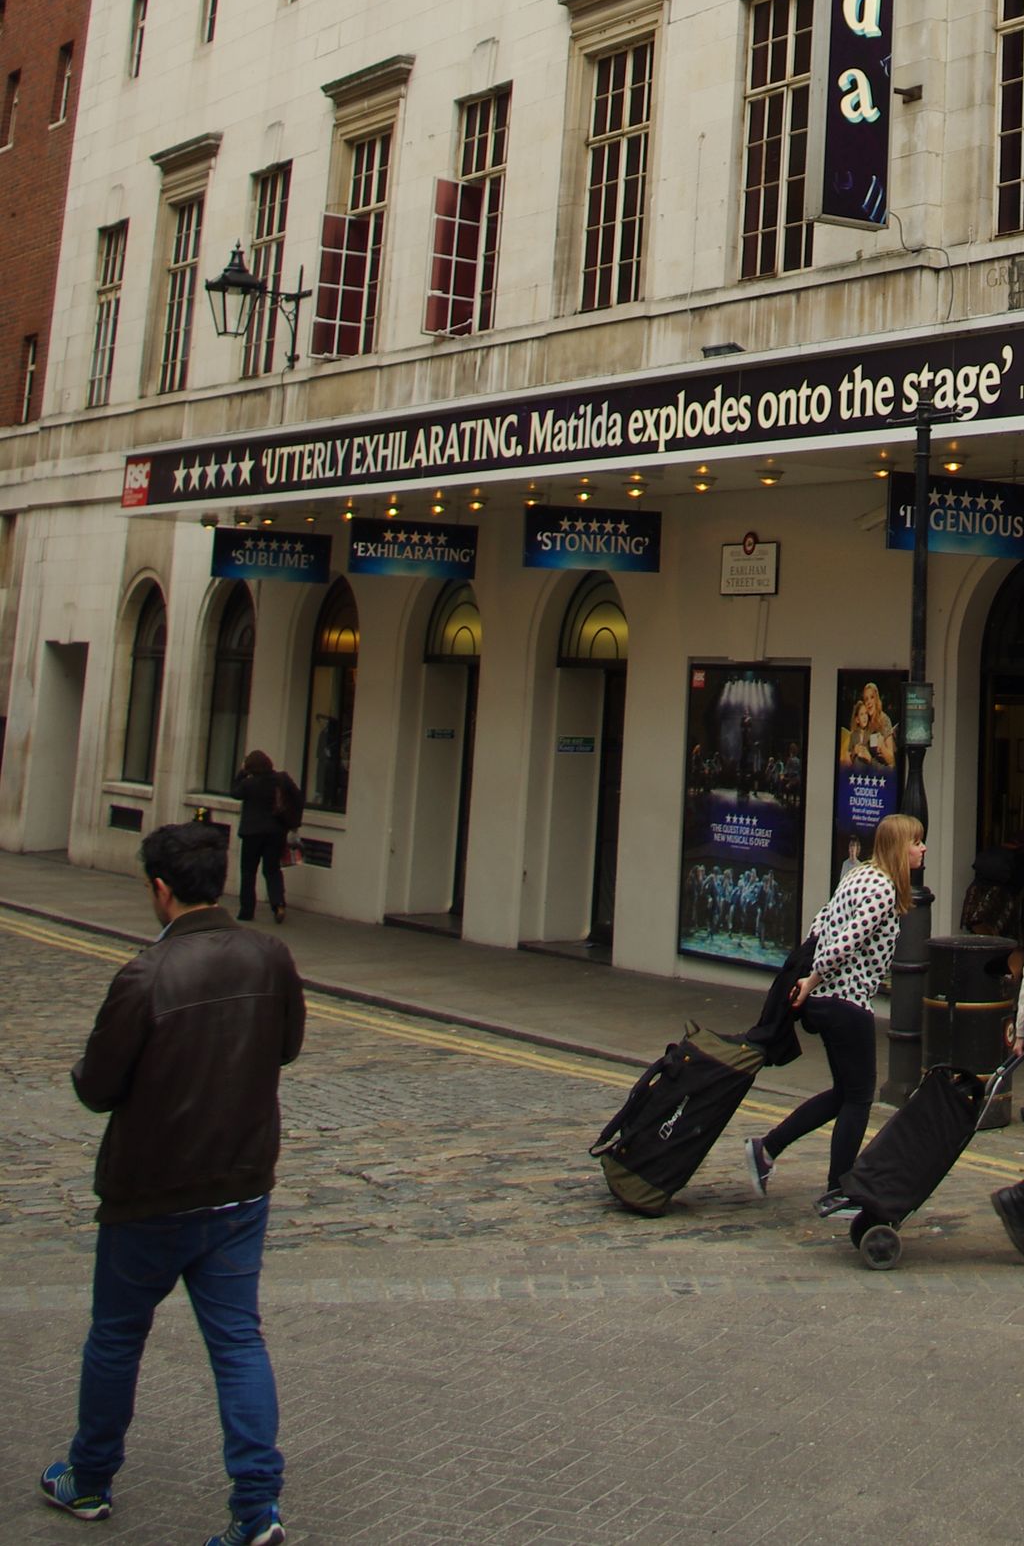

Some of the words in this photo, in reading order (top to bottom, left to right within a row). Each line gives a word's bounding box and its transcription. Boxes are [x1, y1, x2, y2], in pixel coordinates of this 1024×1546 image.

[261, 438, 351, 485] 'UTTERLY
[350, 413, 523, 475] EXHILARATING.
[527, 400, 623, 455] Matilda
[627, 384, 752, 453] explodes
[756, 379, 833, 429] onto
[838, 364, 895, 419] the
[125, 462, 151, 488] RSC
[353, 541, 475, 563] 'EXHILARATING'
[537, 531, 650, 555] 'STONKING'
[231, 549, 315, 569] 'SUBLIME'
